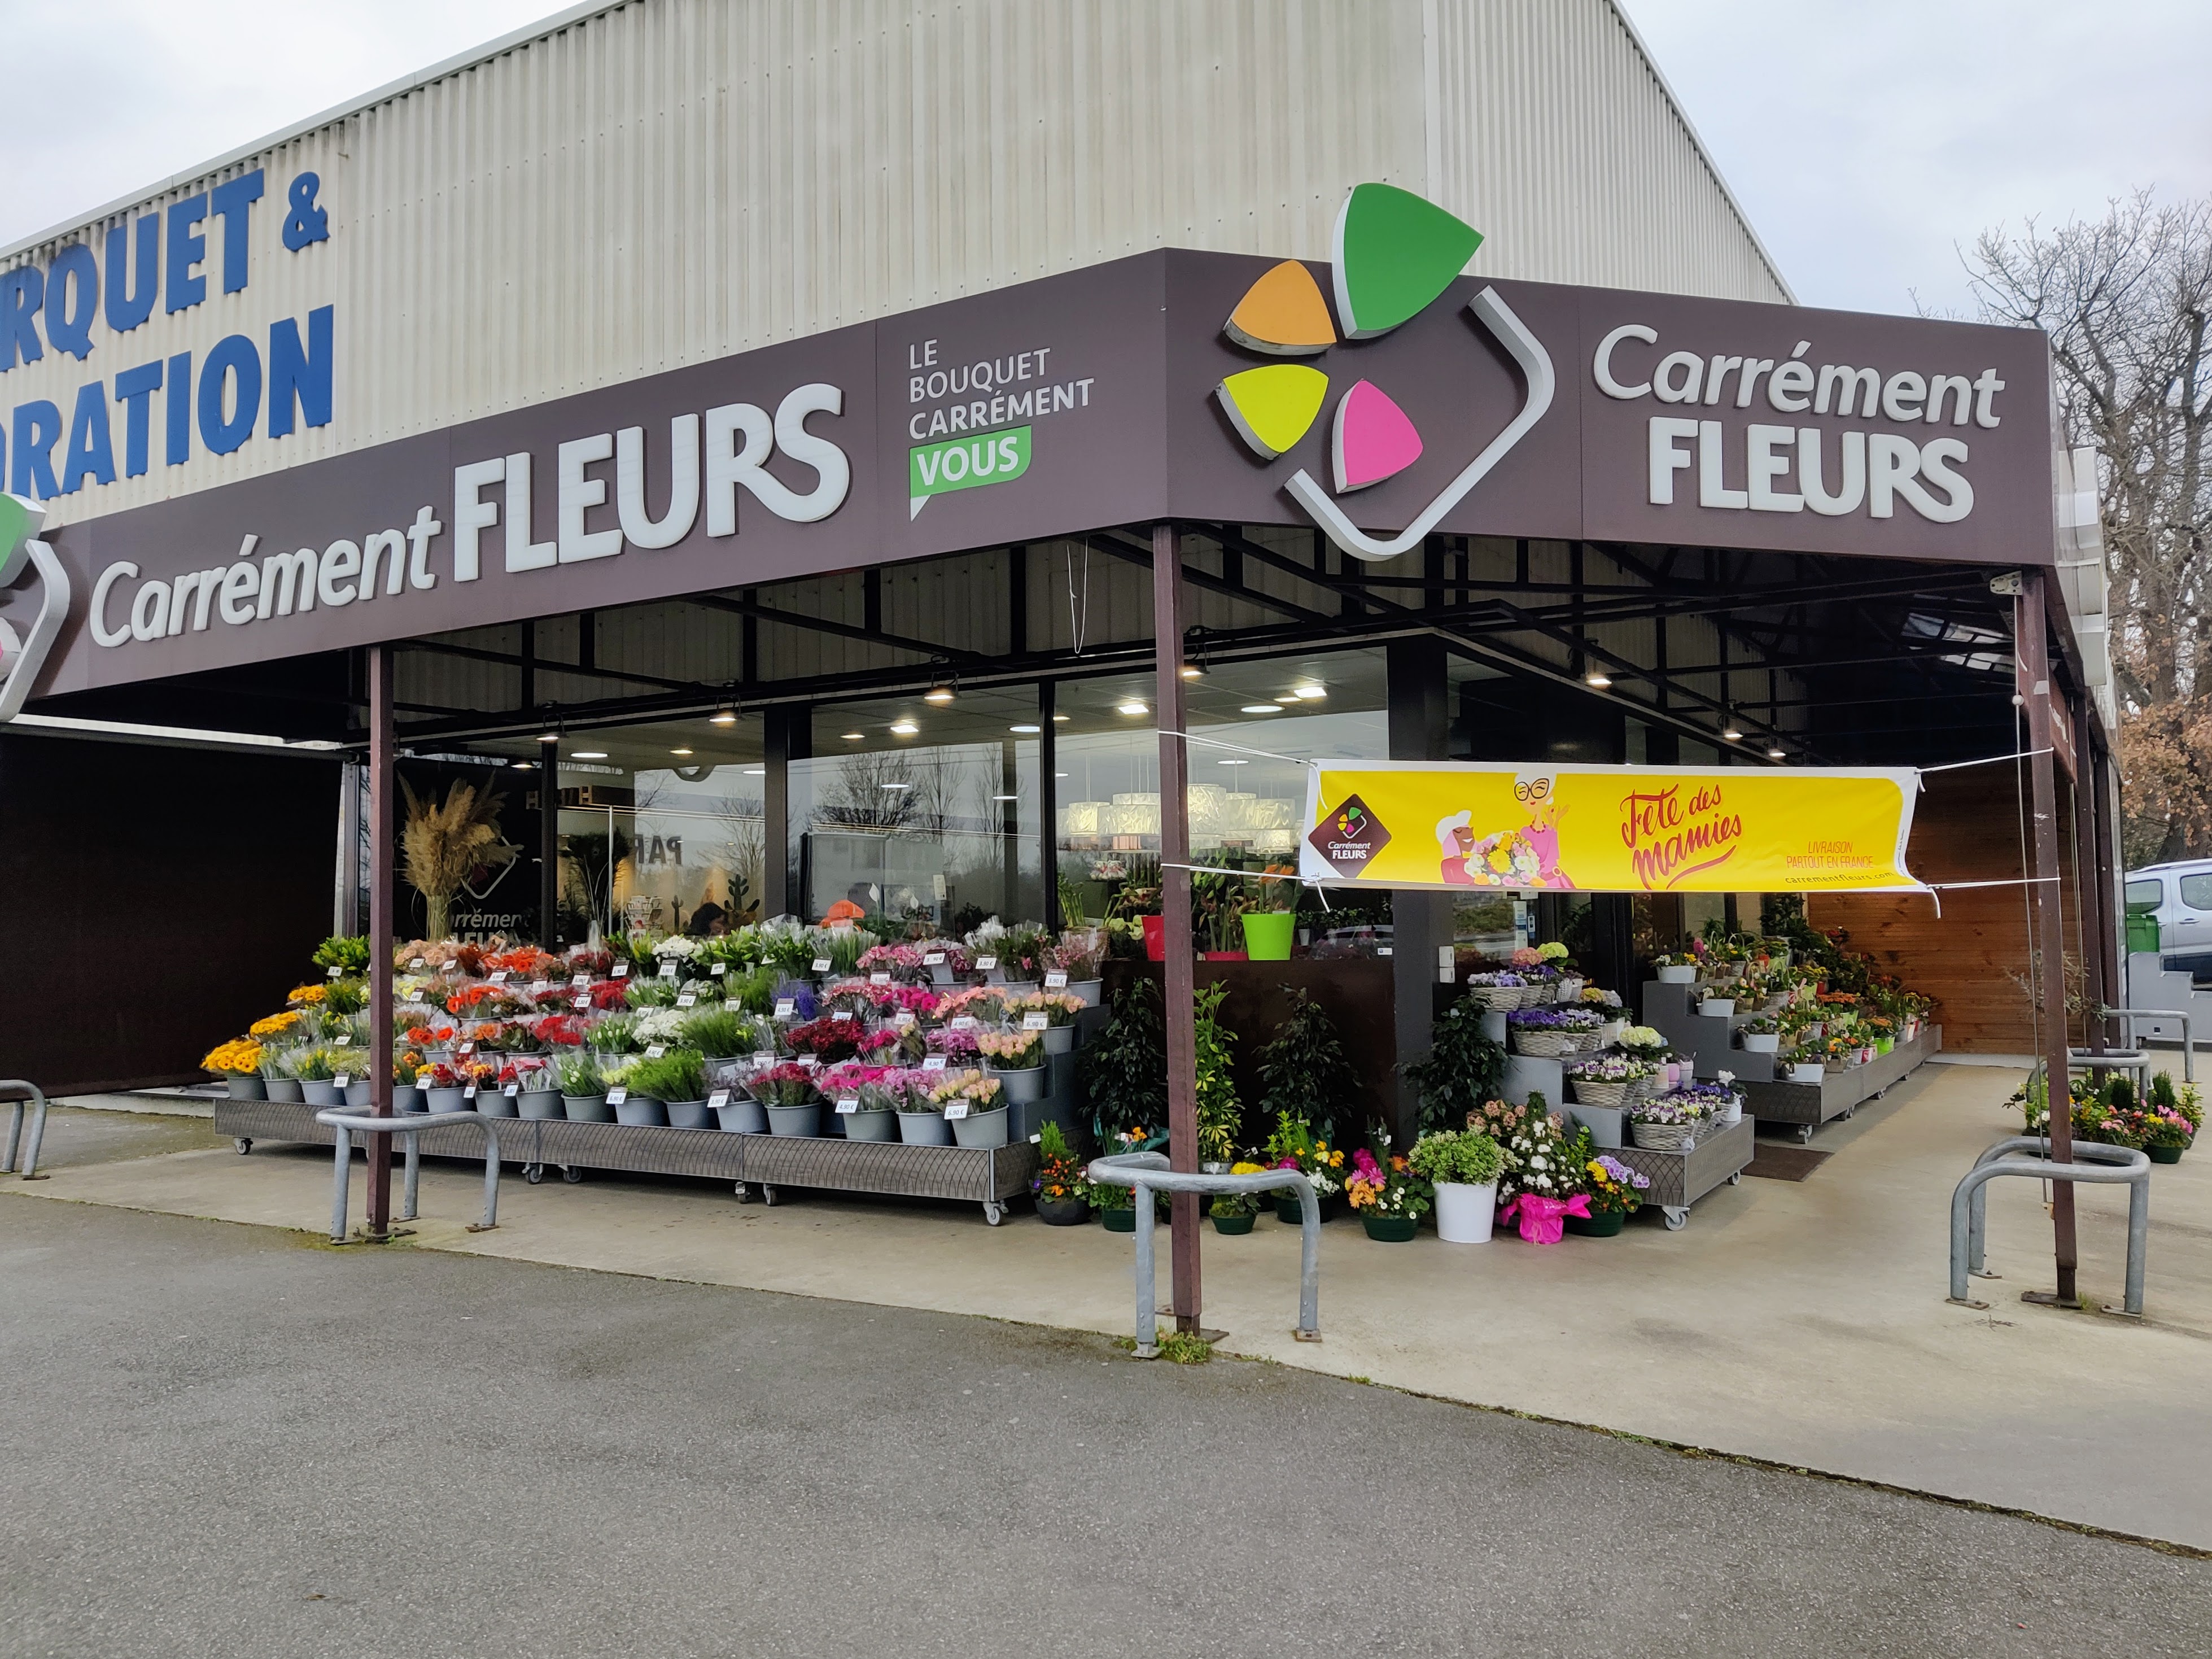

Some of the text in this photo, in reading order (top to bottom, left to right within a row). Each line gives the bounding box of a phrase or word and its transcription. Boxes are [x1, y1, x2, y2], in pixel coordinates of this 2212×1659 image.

[282, 172, 330, 251] &
[910, 339, 938, 370] LE
[910, 347, 1051, 403] BOUQUET
[1593, 324, 2006, 429] Carrément
[0, 304, 333, 500] RATION
[909, 378, 1095, 440] CARRÉMENT
[916, 436, 1019, 486] VOUS
[1649, 416, 1974, 523] FLEURS
[89, 383, 850, 648] Carrément FLEURS
[1328, 841, 1371, 849] Carrément
[1620, 783, 1721, 848] Fête des
[1332, 850, 1367, 859] FLEURS
[1632, 813, 1742, 890] mamies
[1787, 856, 1873, 868] PARTOUT EN FRANCE
[1808, 841, 1853, 853] LIVRAISON
[1786, 872, 1894, 884] carrementfleurs.com
